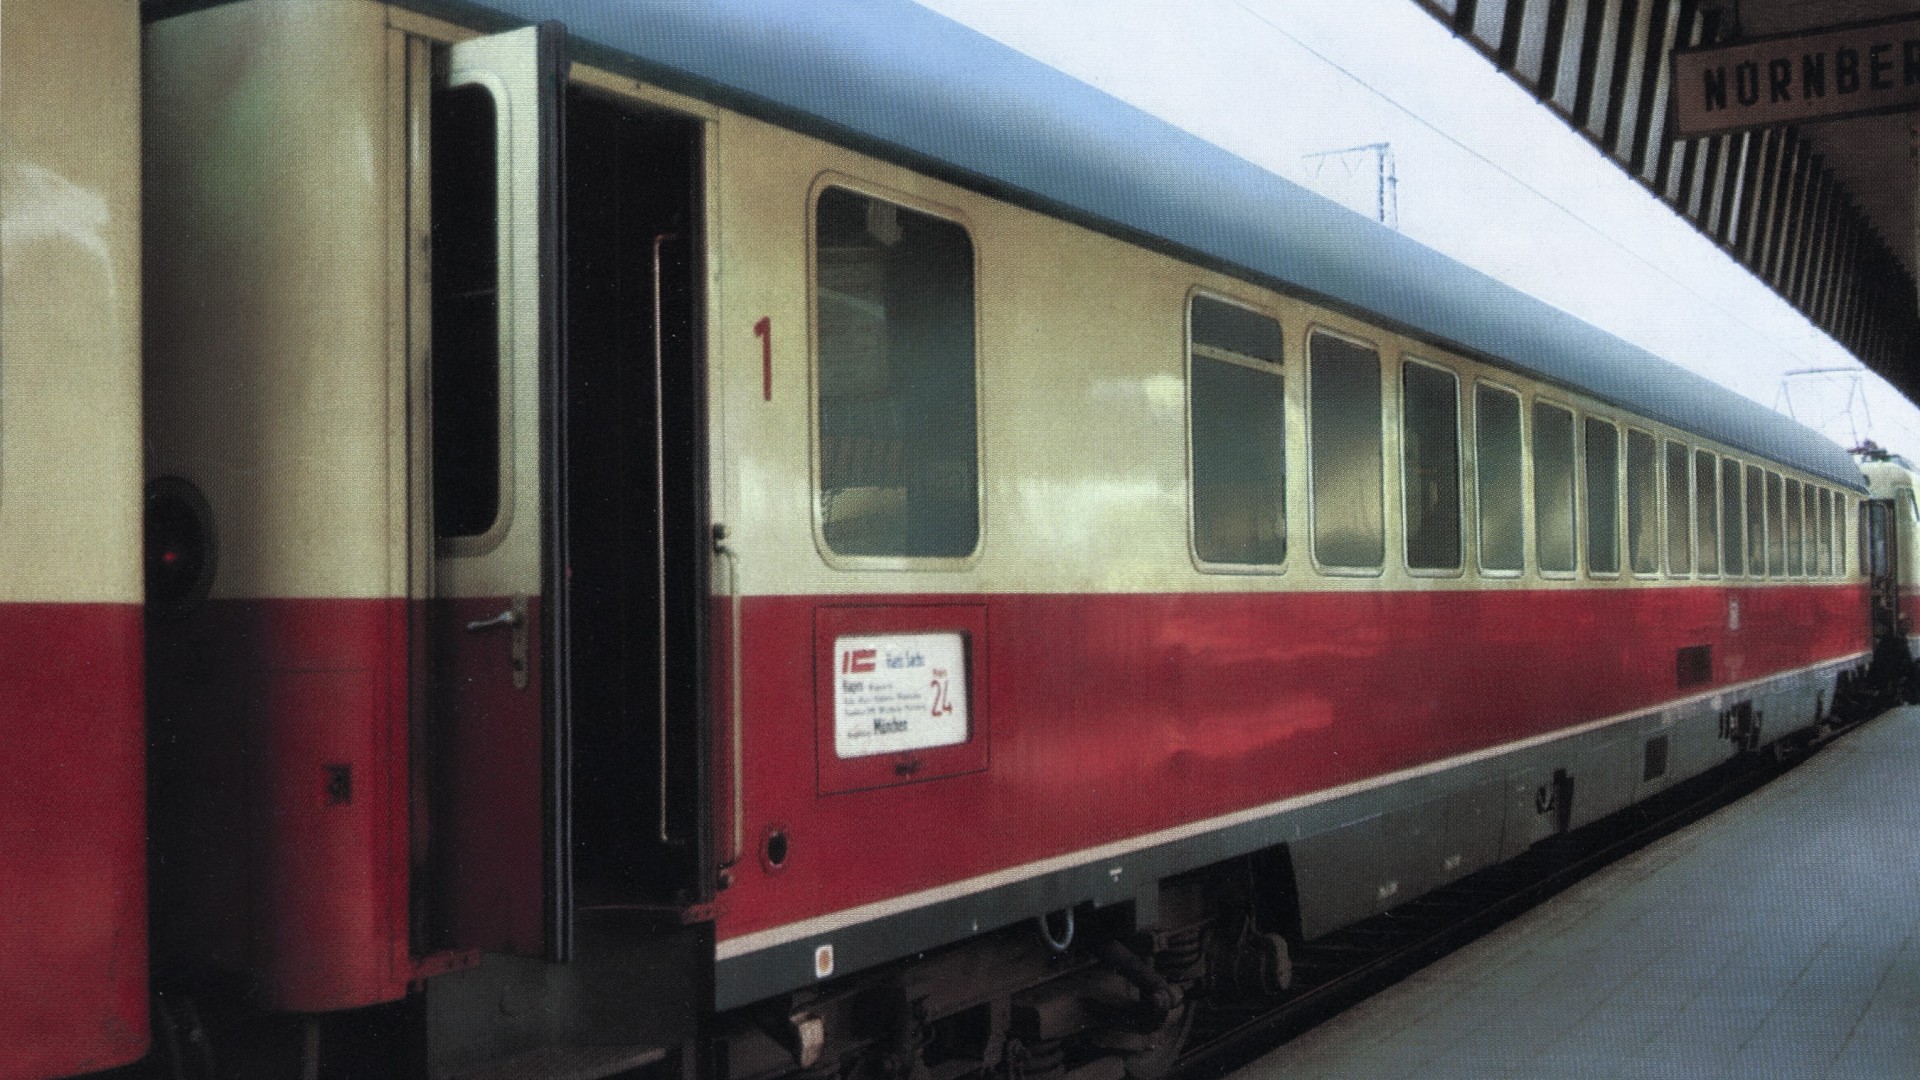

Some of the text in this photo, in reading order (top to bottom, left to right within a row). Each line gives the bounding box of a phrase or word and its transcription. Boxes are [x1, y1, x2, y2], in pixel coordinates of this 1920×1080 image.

[753, 316, 771, 401] 1
[842, 649, 877, 674] IC
[931, 680, 953, 717] 24
